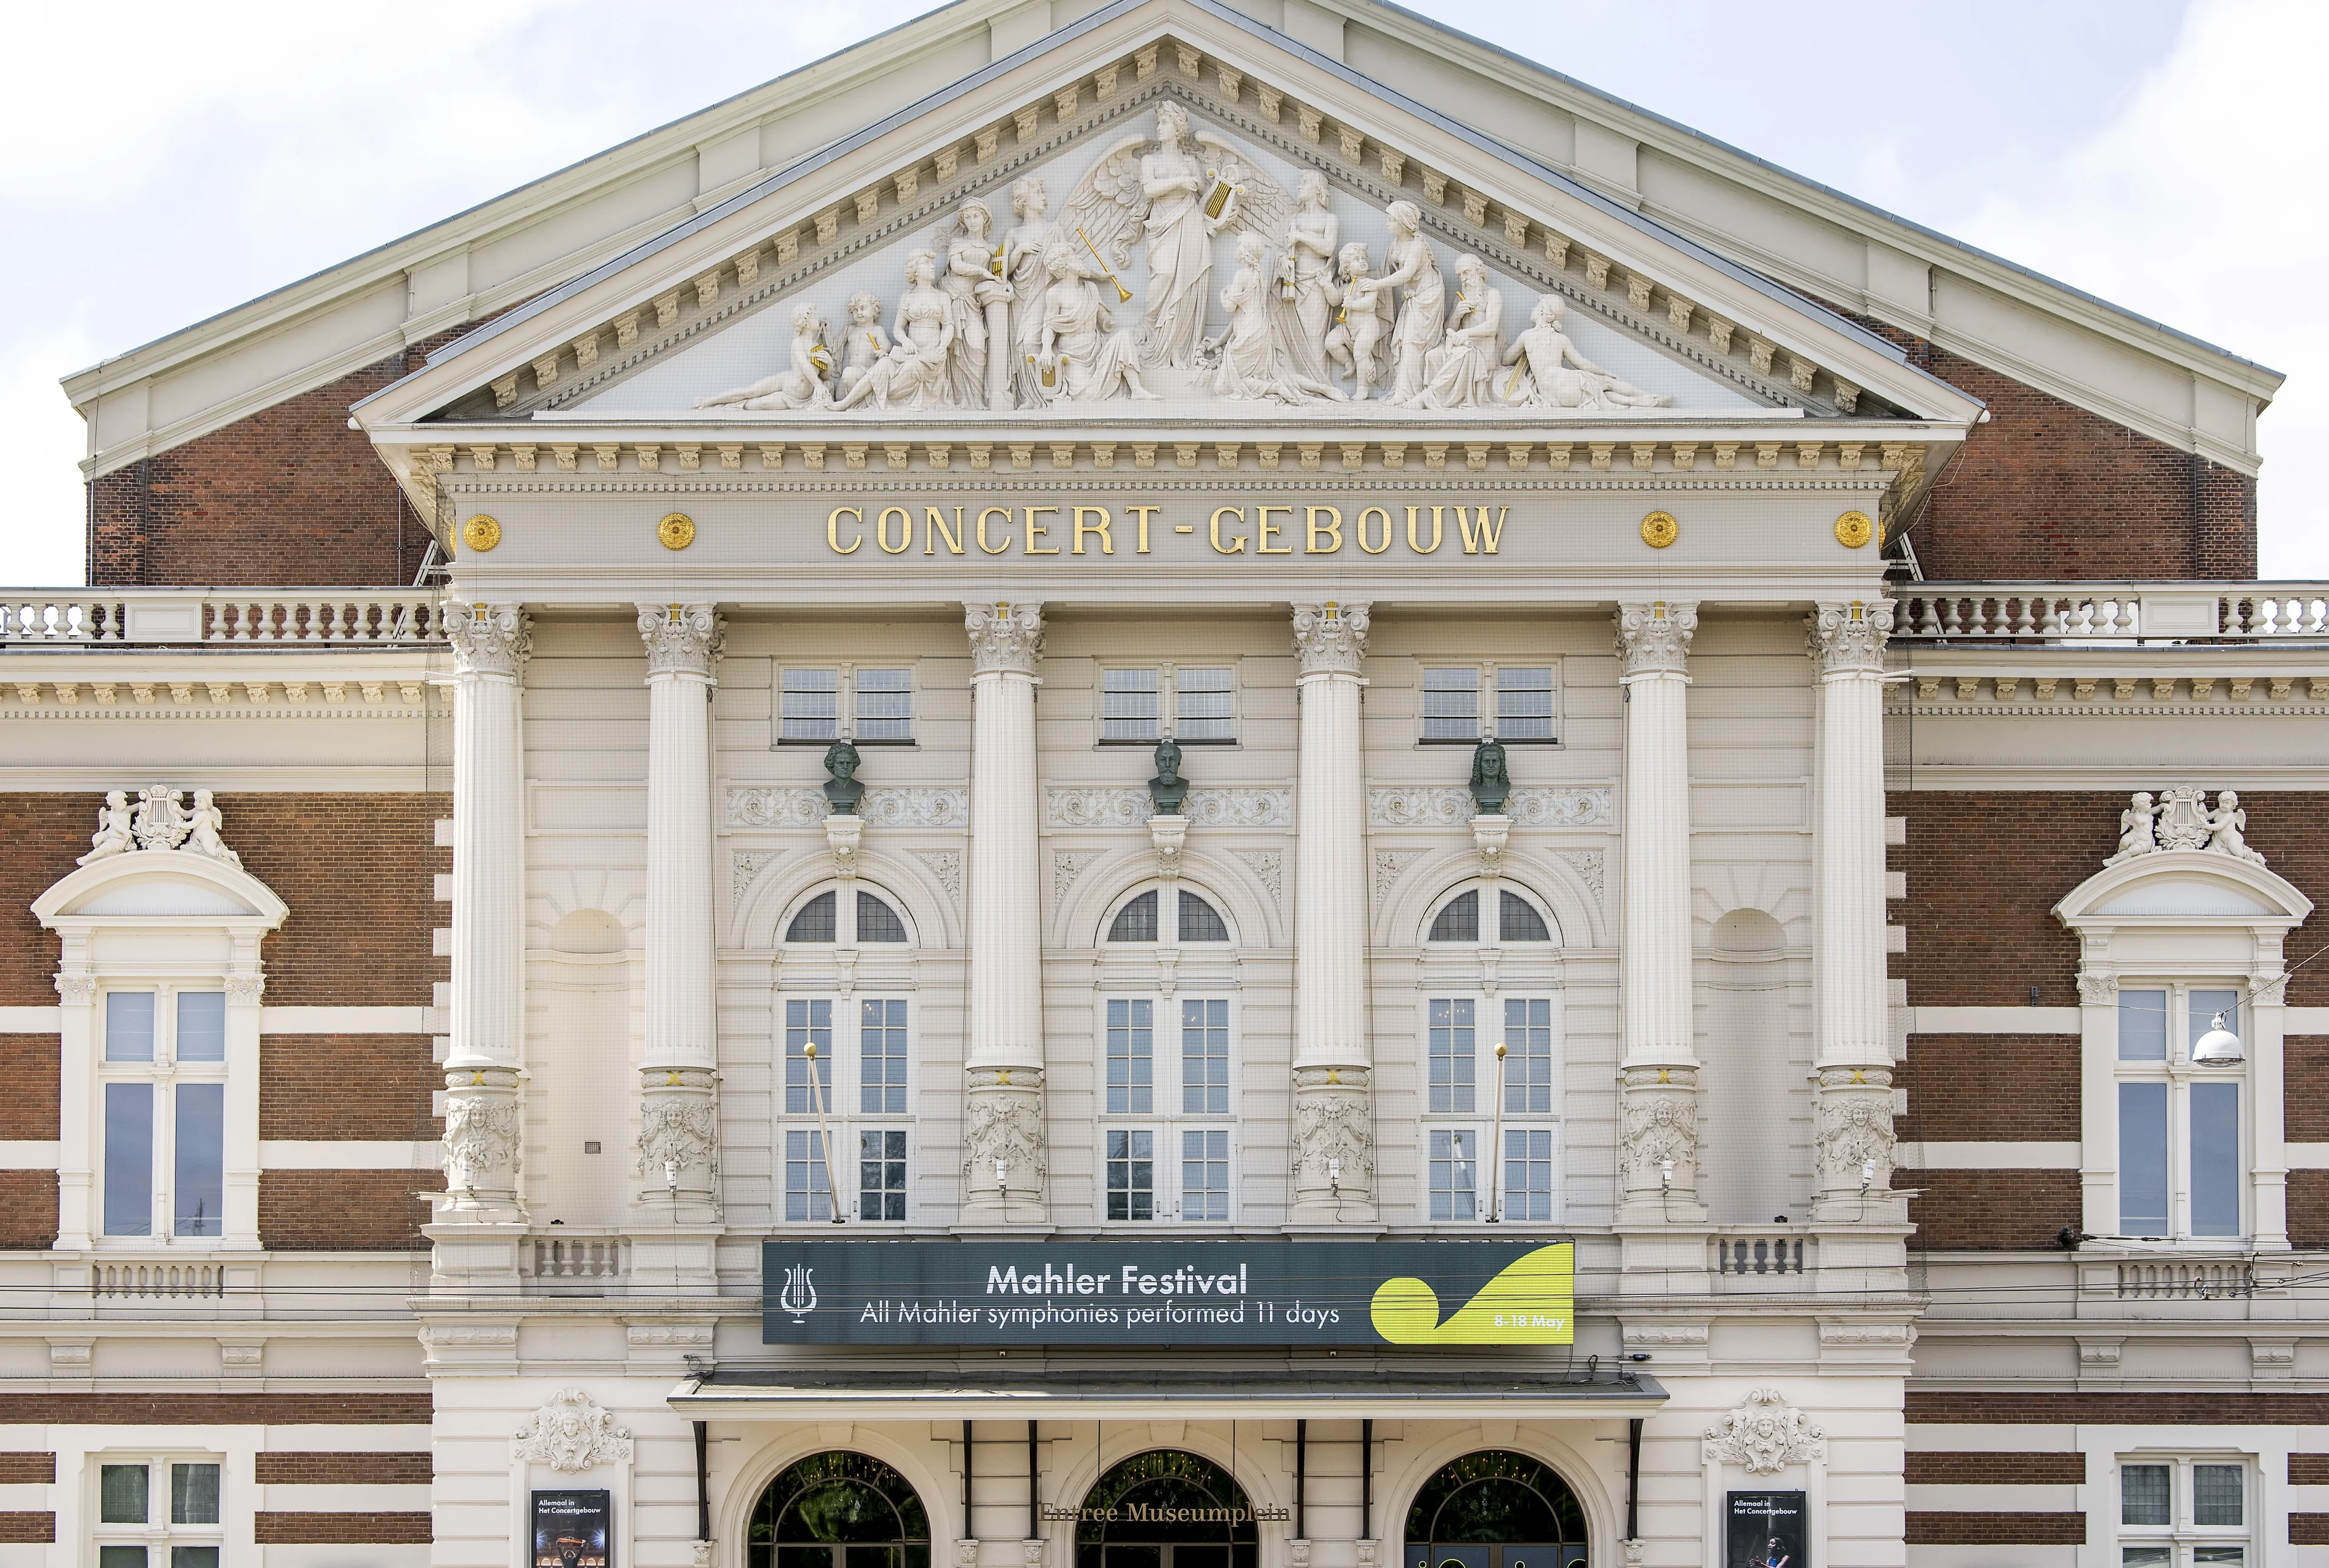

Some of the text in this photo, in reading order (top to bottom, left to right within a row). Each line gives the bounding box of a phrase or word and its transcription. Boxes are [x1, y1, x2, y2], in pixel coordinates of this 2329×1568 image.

[986, 1263, 1247, 1294] Mahler Festival
[860, 1300, 1340, 1329] All Mahler symphonies performed 11 days
[1494, 1314, 1565, 1331] 8-18 May
[551, 1507, 601, 1515] Concertgebouw
[1037, 1501, 1291, 1527] Entree Museumplein
[1747, 1507, 1797, 1516] Concertgebouw
